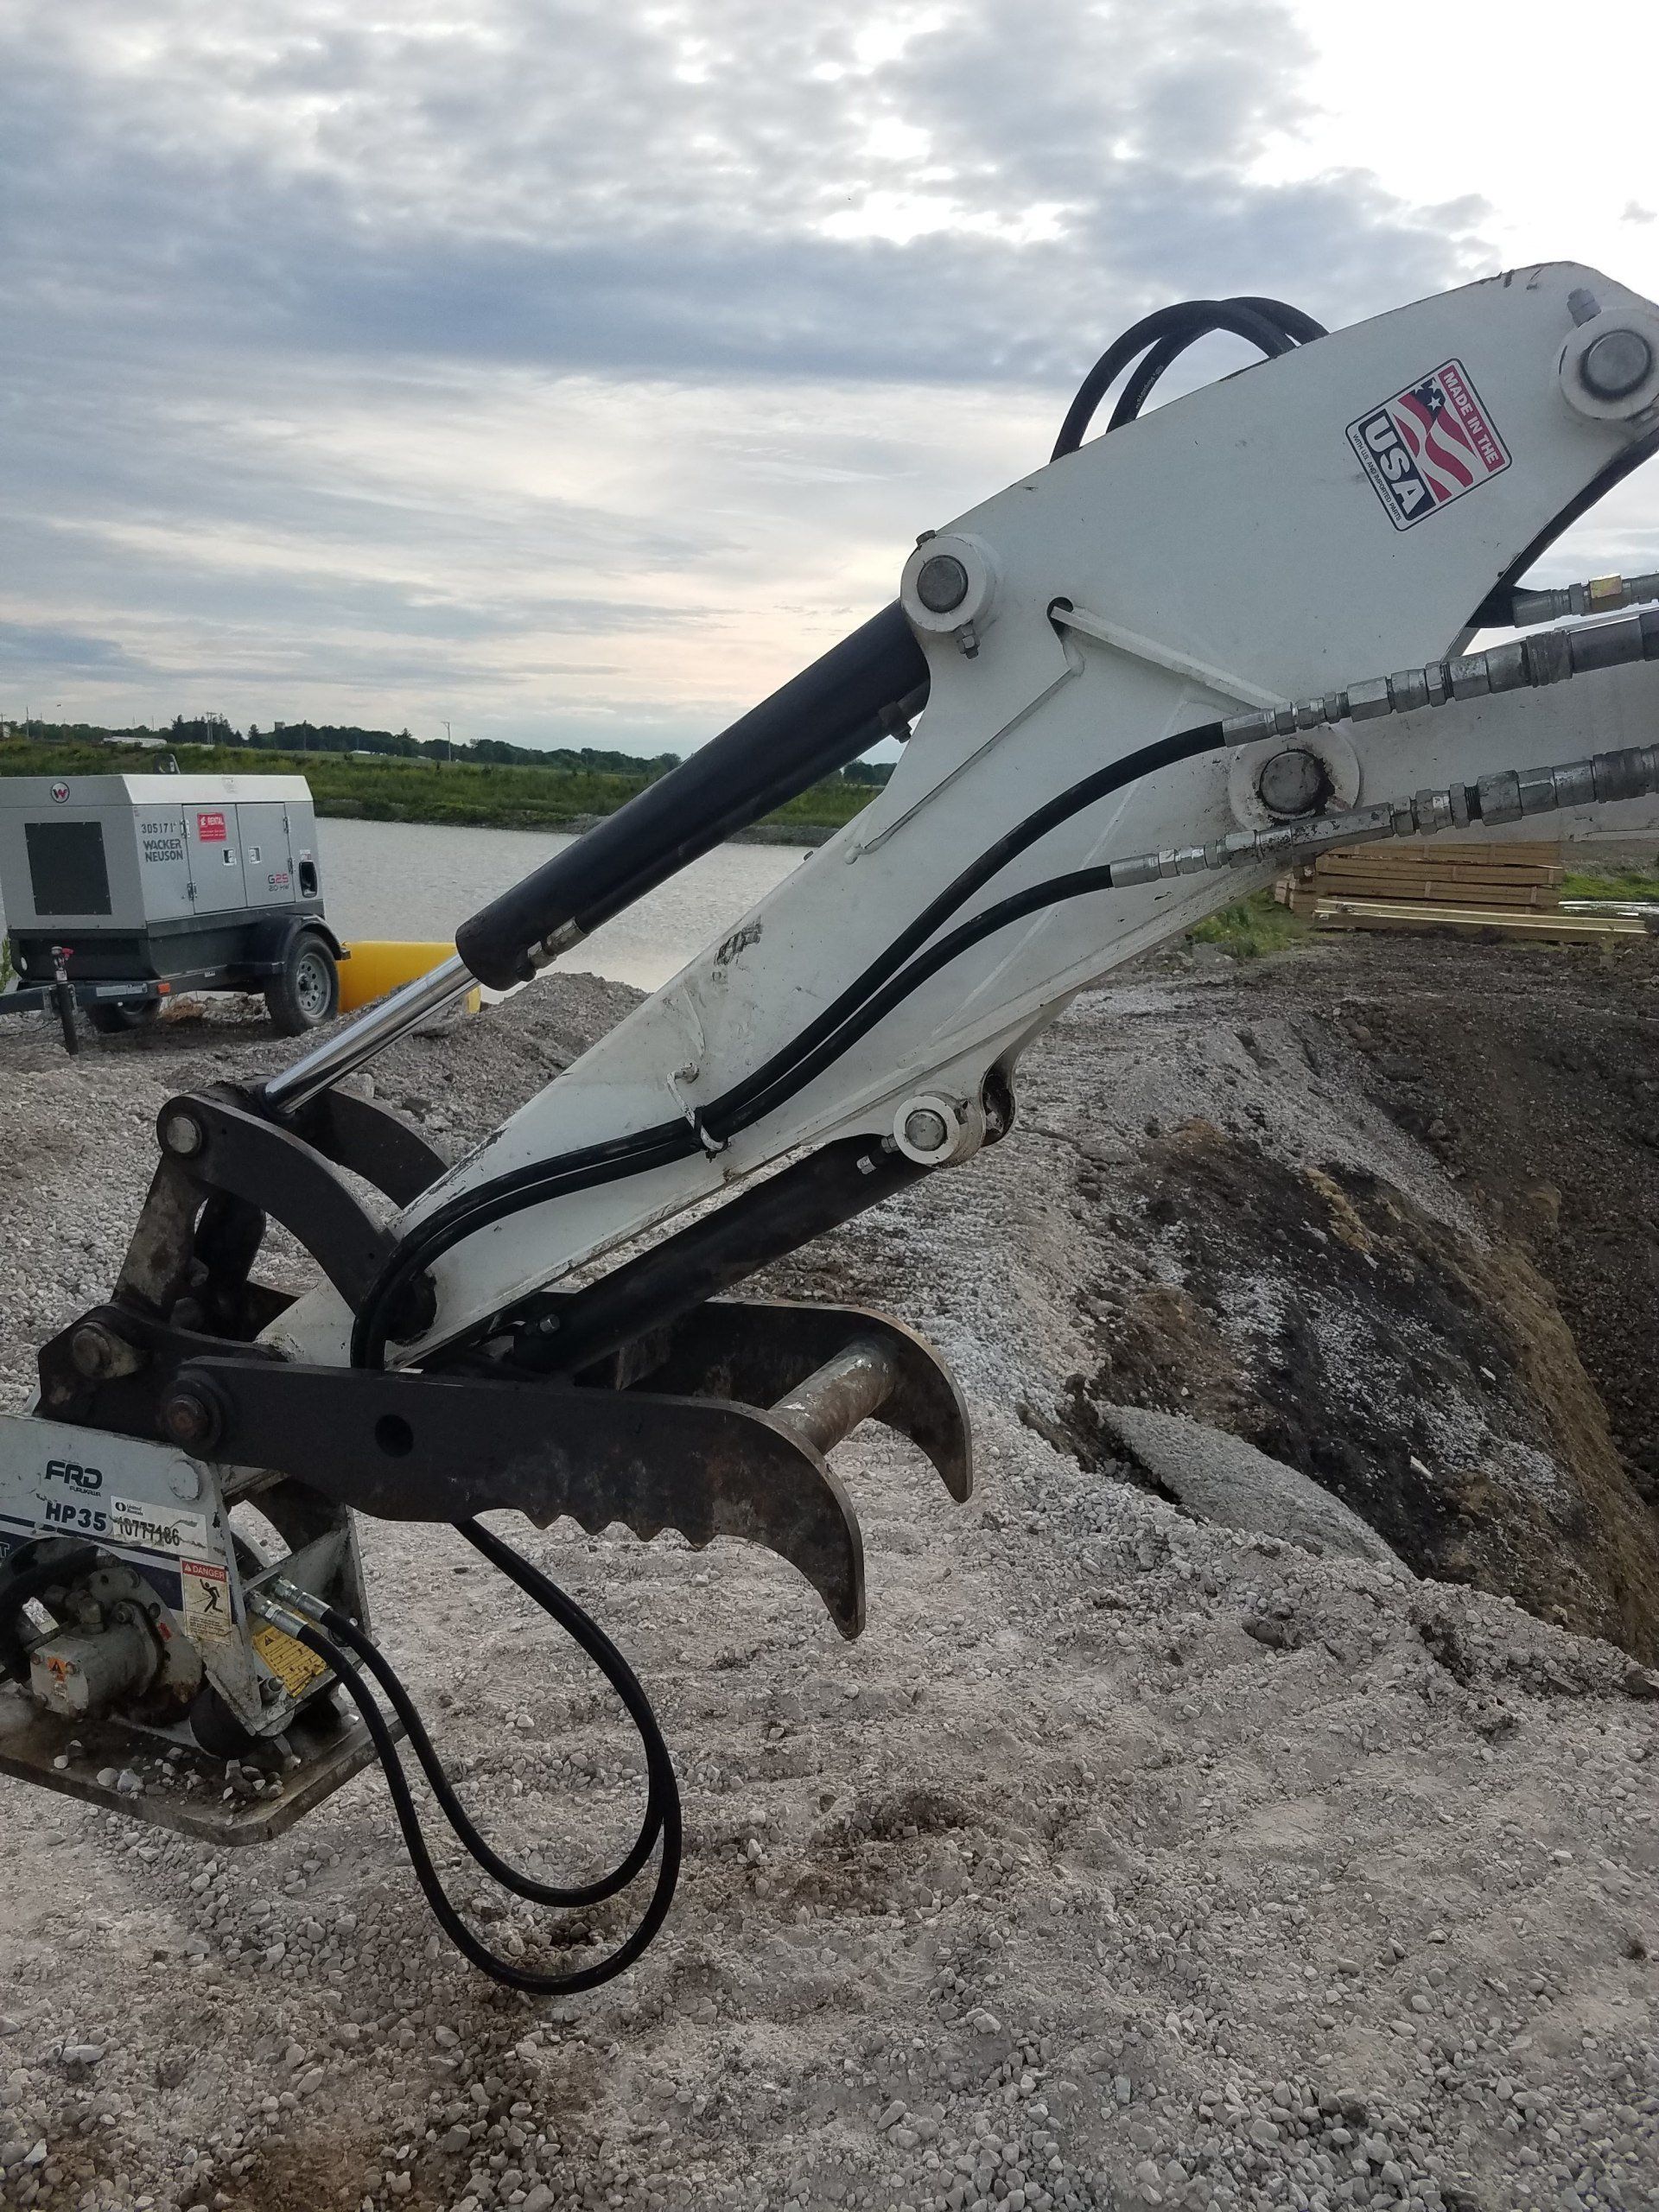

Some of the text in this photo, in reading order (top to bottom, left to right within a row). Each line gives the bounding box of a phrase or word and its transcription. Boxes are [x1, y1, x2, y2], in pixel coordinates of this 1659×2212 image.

[1444, 372, 1499, 464] MADE IN THE
[1353, 434, 1402, 521] WITH U.S. AND IMPORTED PARTS
[1365, 416, 1426, 515] USA
[143, 839, 181, 851] WACKER
[145, 850, 183, 862] NEUSON
[268, 874, 289, 884] G25
[44, 1459, 103, 1490] FRD
[45, 1501, 107, 1531] HP35
[193, 1566, 225, 1579] DANGER
